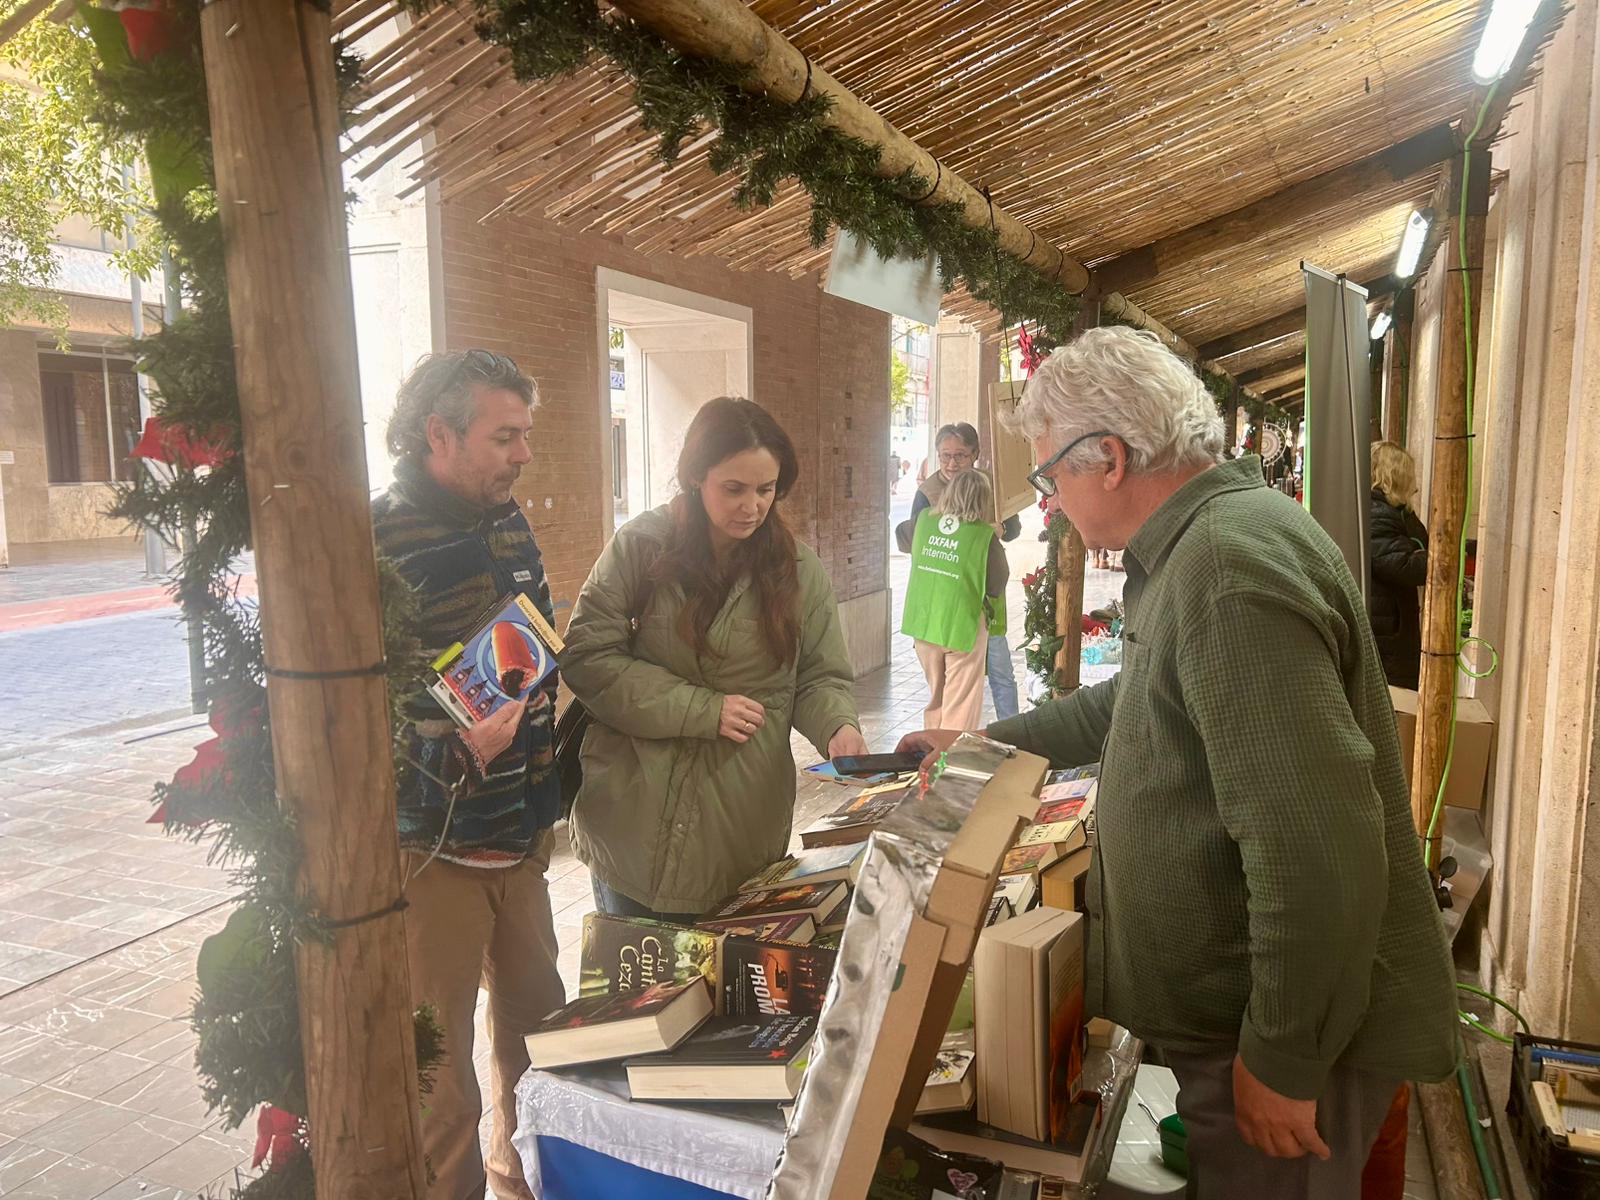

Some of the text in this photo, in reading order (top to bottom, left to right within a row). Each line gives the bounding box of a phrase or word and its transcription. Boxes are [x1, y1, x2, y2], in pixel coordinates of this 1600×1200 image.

[928, 535, 959, 550] OXFAM
[921, 545, 960, 564] Intermón
[656, 957, 668, 973] La
[747, 963, 776, 1015] PROM
[772, 998, 791, 1015] LA
